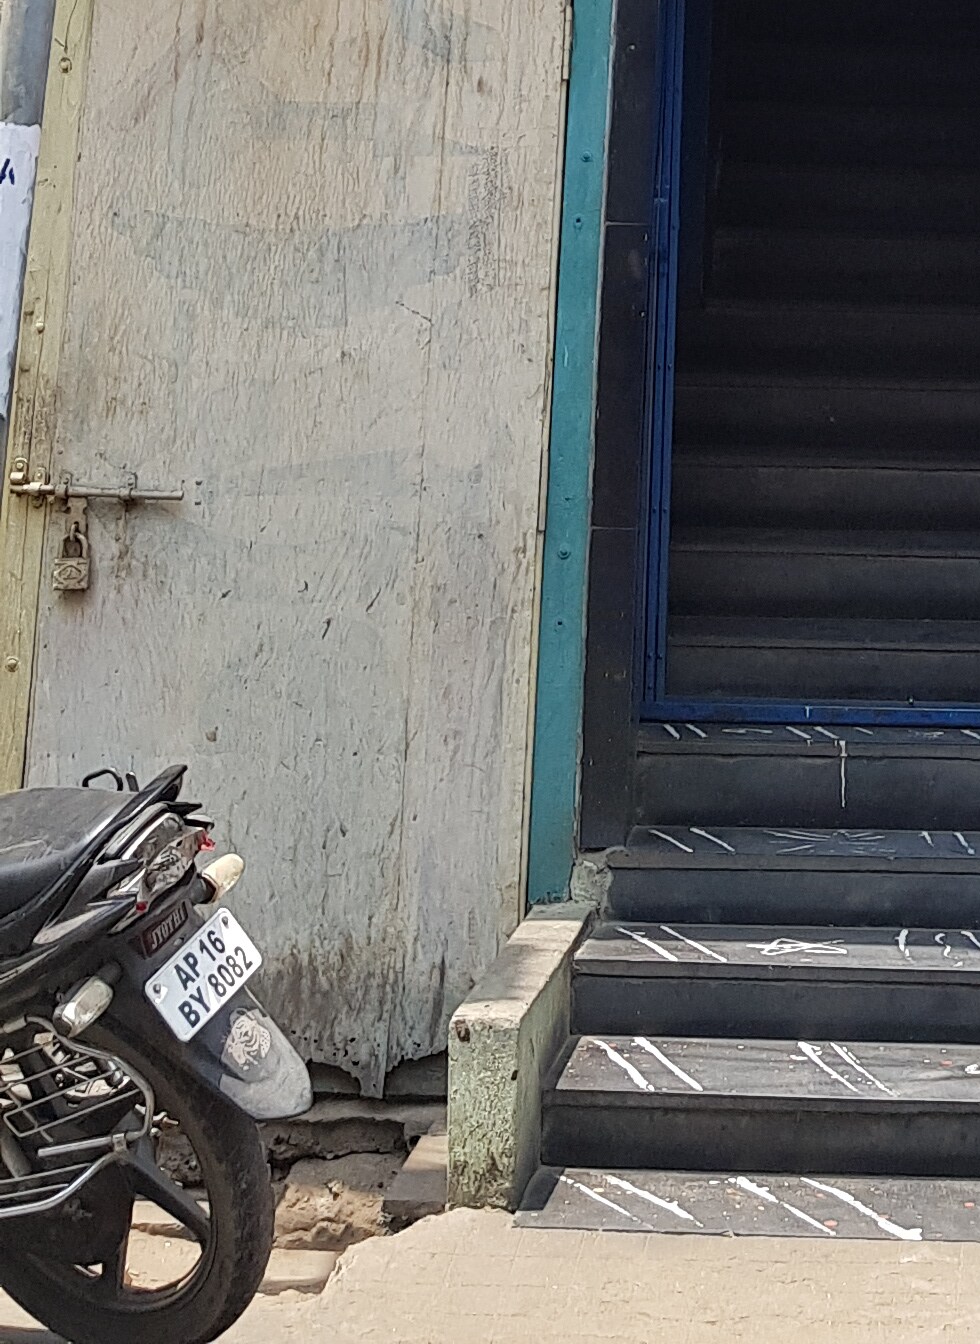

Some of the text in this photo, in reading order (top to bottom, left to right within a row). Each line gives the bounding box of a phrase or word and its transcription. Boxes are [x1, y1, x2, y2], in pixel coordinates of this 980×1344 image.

[174, 929, 226, 991] AP 16
[178, 945, 254, 1029] BY 8082
